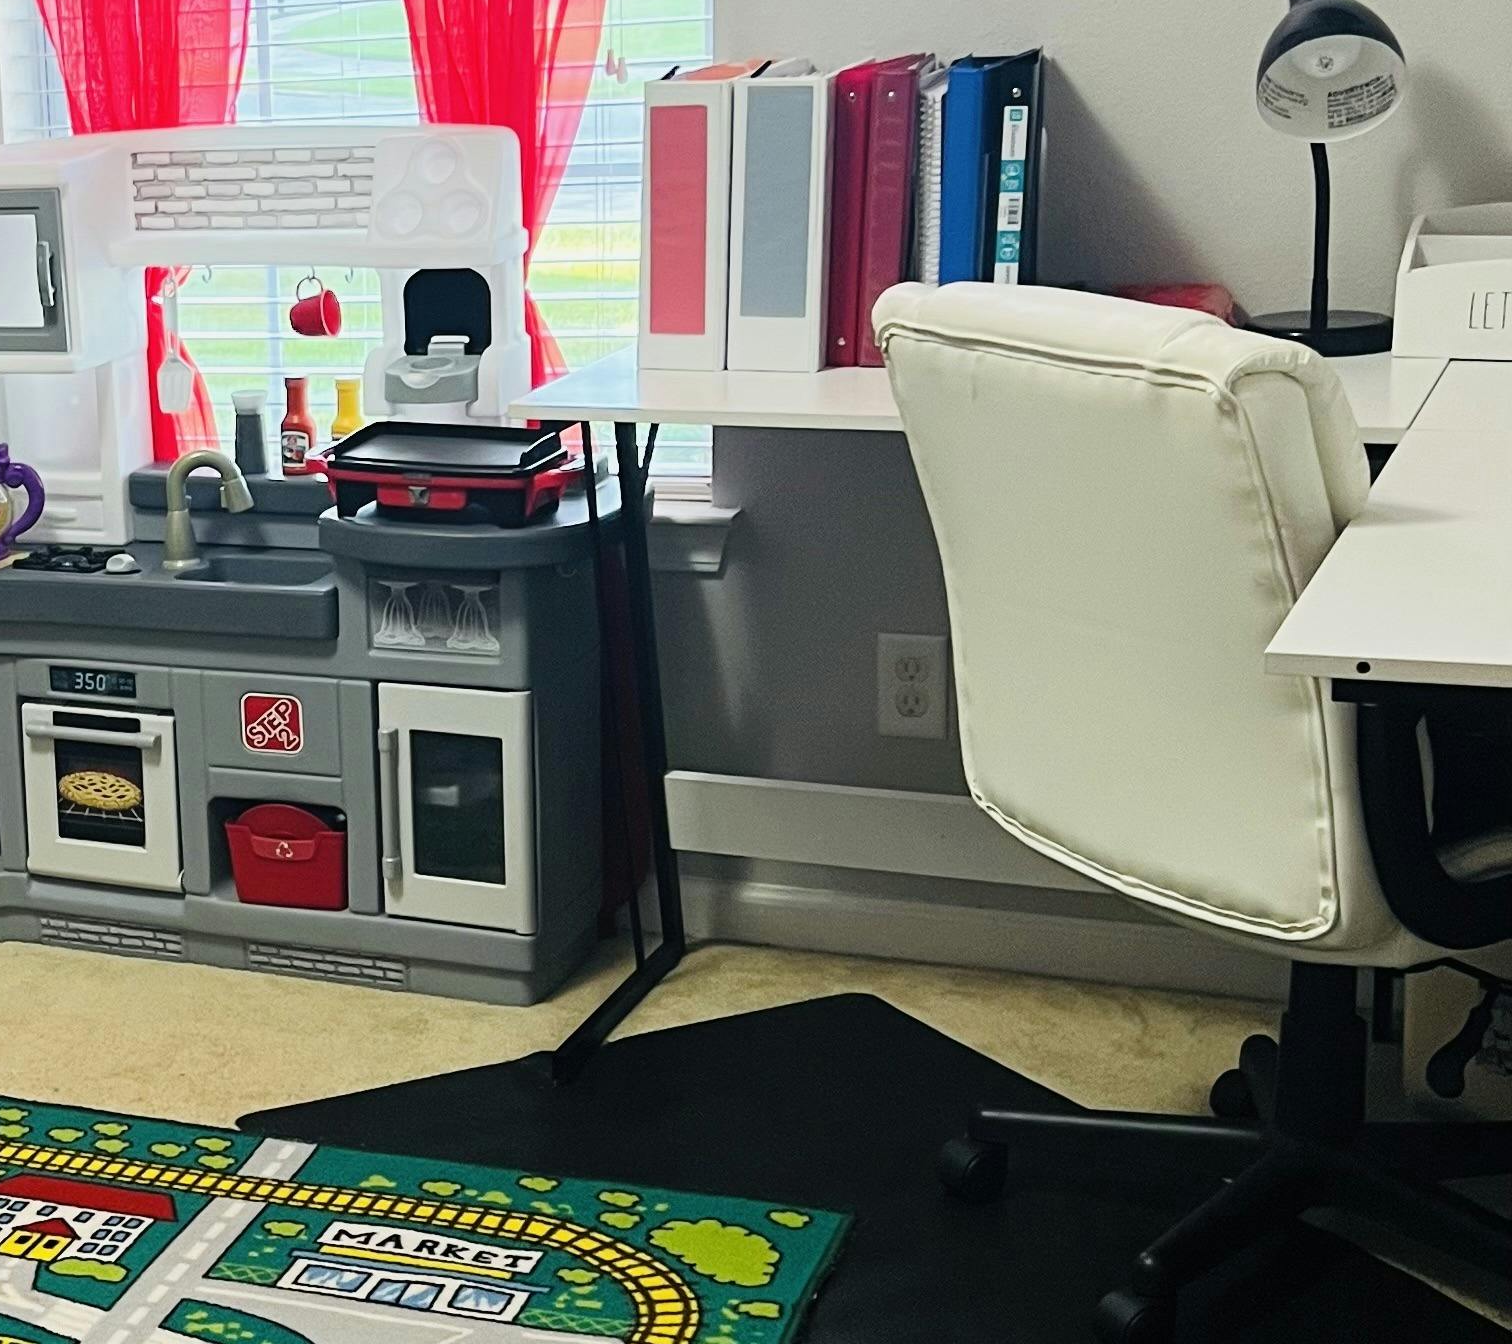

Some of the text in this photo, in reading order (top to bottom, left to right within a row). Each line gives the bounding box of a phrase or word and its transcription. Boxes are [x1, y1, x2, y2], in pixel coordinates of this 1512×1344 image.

[74, 672, 106, 691] 350
[247, 700, 291, 746] STEP
[331, 1227, 533, 1274] MARKET
